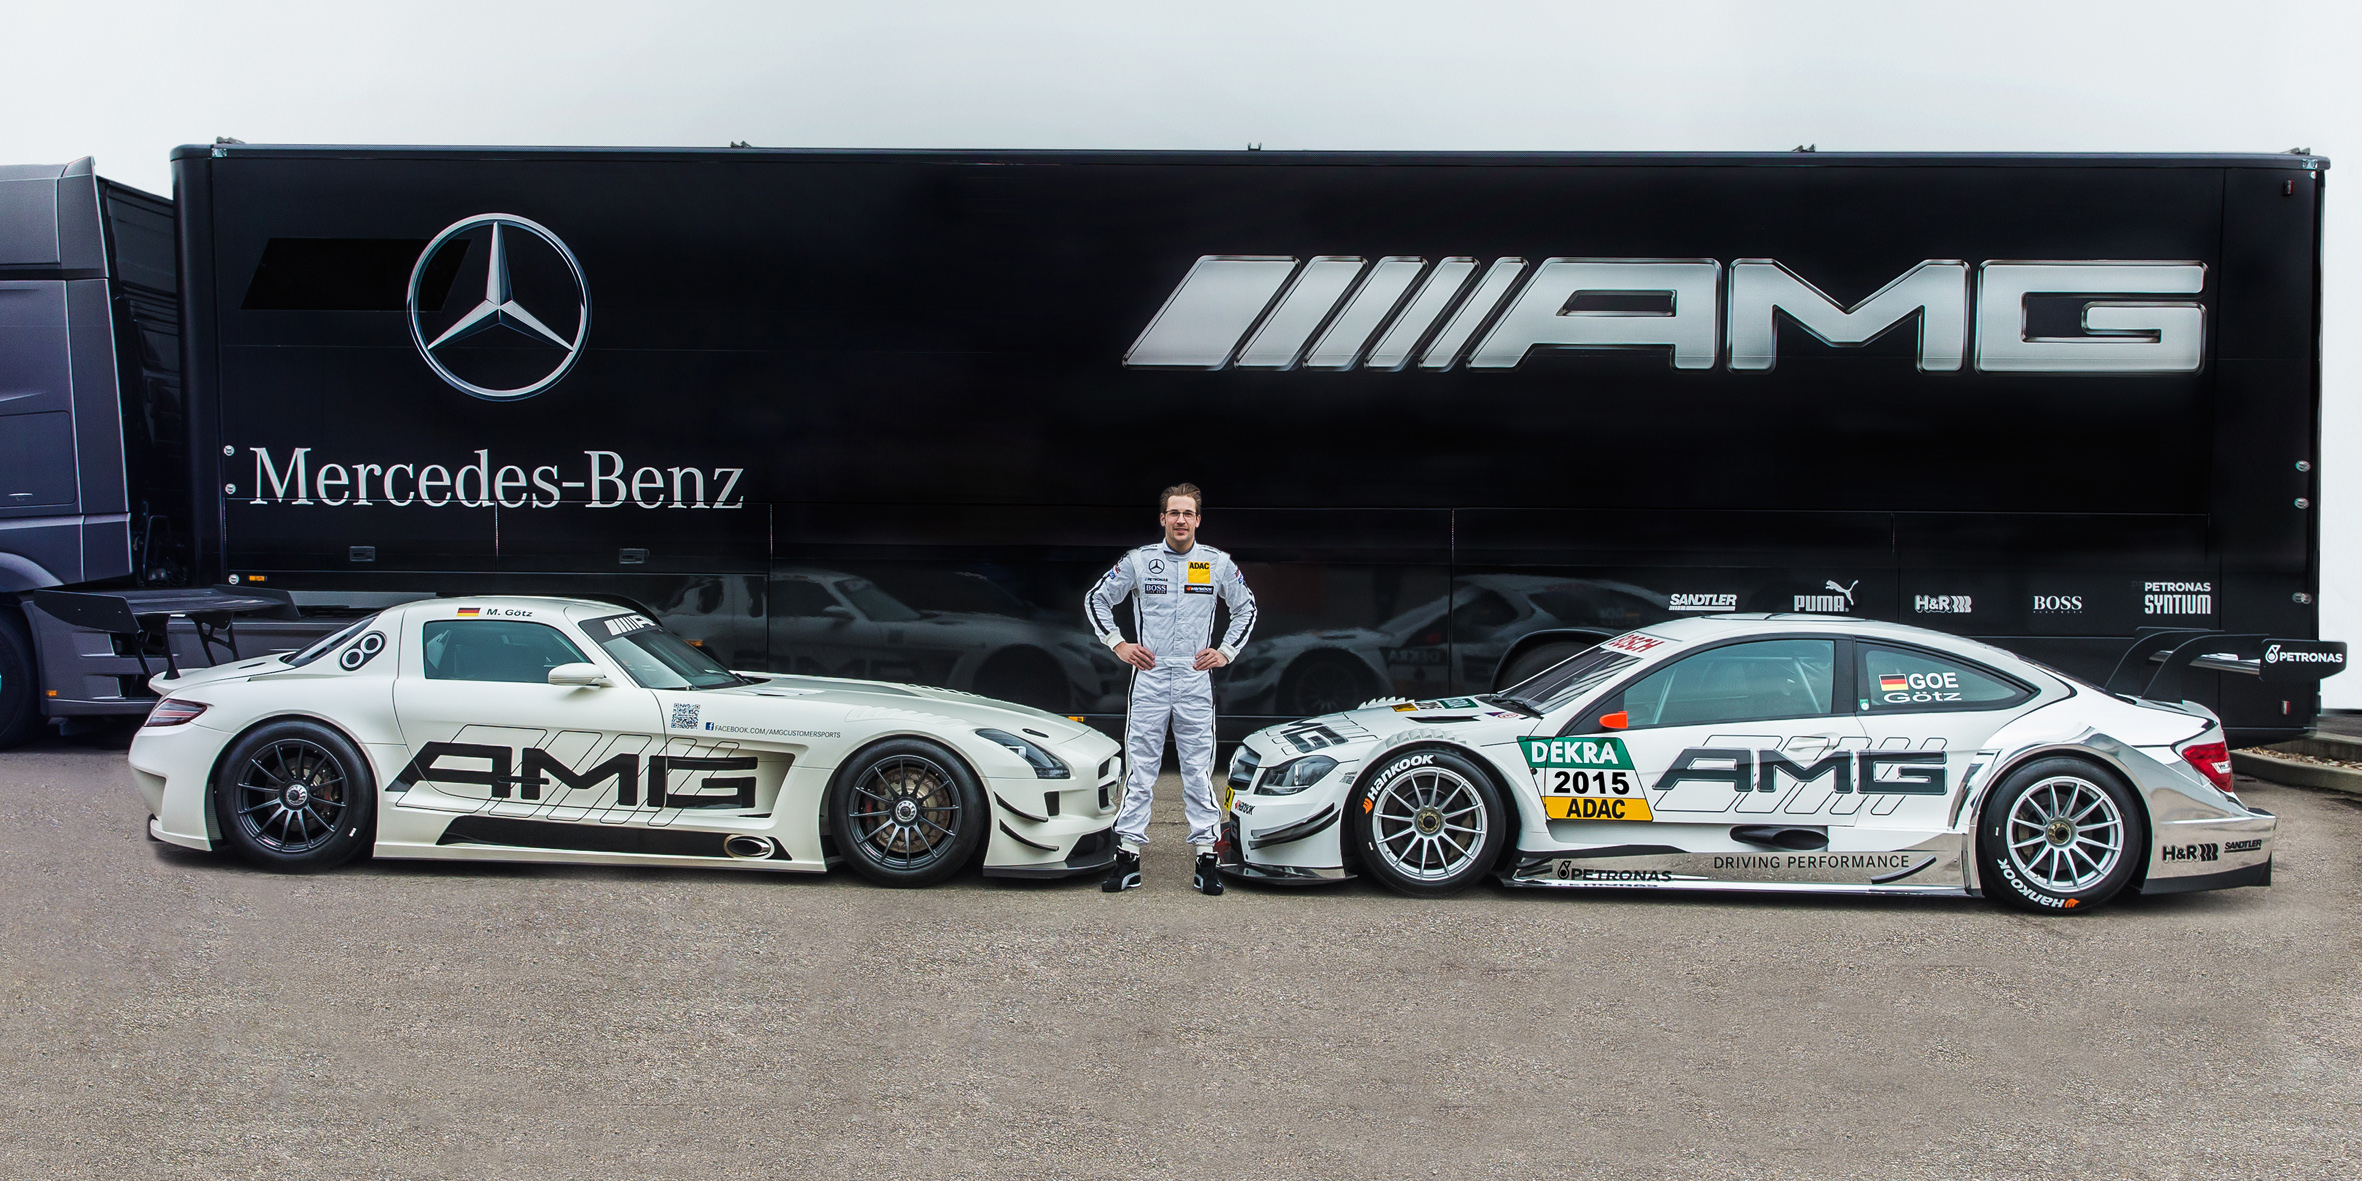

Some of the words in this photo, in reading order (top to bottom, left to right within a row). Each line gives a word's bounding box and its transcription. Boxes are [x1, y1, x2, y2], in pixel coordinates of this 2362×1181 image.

[1466, 256, 2208, 373] AMG
[249, 447, 745, 510] Mercedes-Benz
[1188, 562, 1210, 570] ADAC
[2144, 582, 2212, 592] PETRONAS
[1669, 593, 1738, 606] SANDTLER
[1793, 595, 1845, 612] PUMA
[1914, 595, 1951, 613] H&R
[2033, 595, 2083, 610] BOSS
[2144, 594, 2212, 615] SYNTIUM
[486, 608, 501, 616] M.
[504, 608, 533, 618] Götz
[2279, 652, 2344, 664] PETRONAS
[1908, 672, 1959, 690] GOE
[1883, 691, 1963, 703] Götz
[714, 724, 842, 739] FACEBOOK.COM/AMGCUSTOMERSPORTS
[1531, 740, 1619, 765] DEKRA
[386, 741, 760, 810] AMG
[1651, 747, 1949, 796] AMG
[1553, 770, 1630, 795] 2015
[1565, 798, 1626, 820] ADAC
[2161, 844, 2199, 862] H&R
[2224, 838, 2263, 851] SANDTLER
[1713, 855, 1781, 869] DRIVING
[1787, 855, 1910, 869] PERFORMANCE
[1571, 867, 1673, 882] PETRONAS
